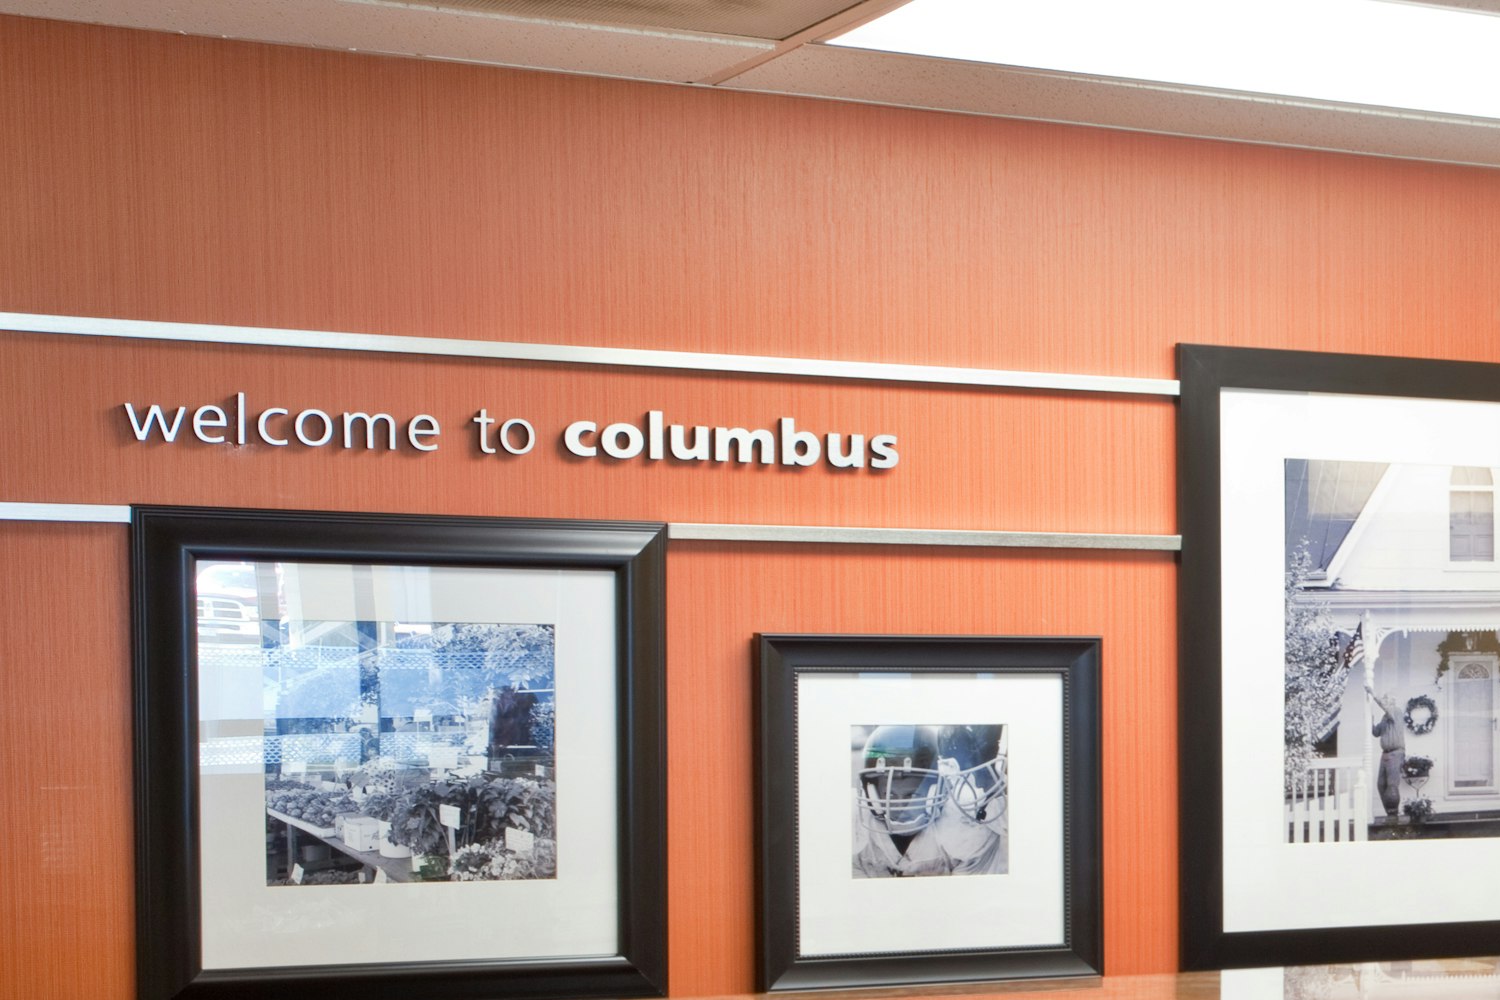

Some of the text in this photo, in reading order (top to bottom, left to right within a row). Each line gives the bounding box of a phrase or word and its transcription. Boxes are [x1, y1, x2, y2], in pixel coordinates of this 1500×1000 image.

[124, 391, 899, 469] welcome to columbus
